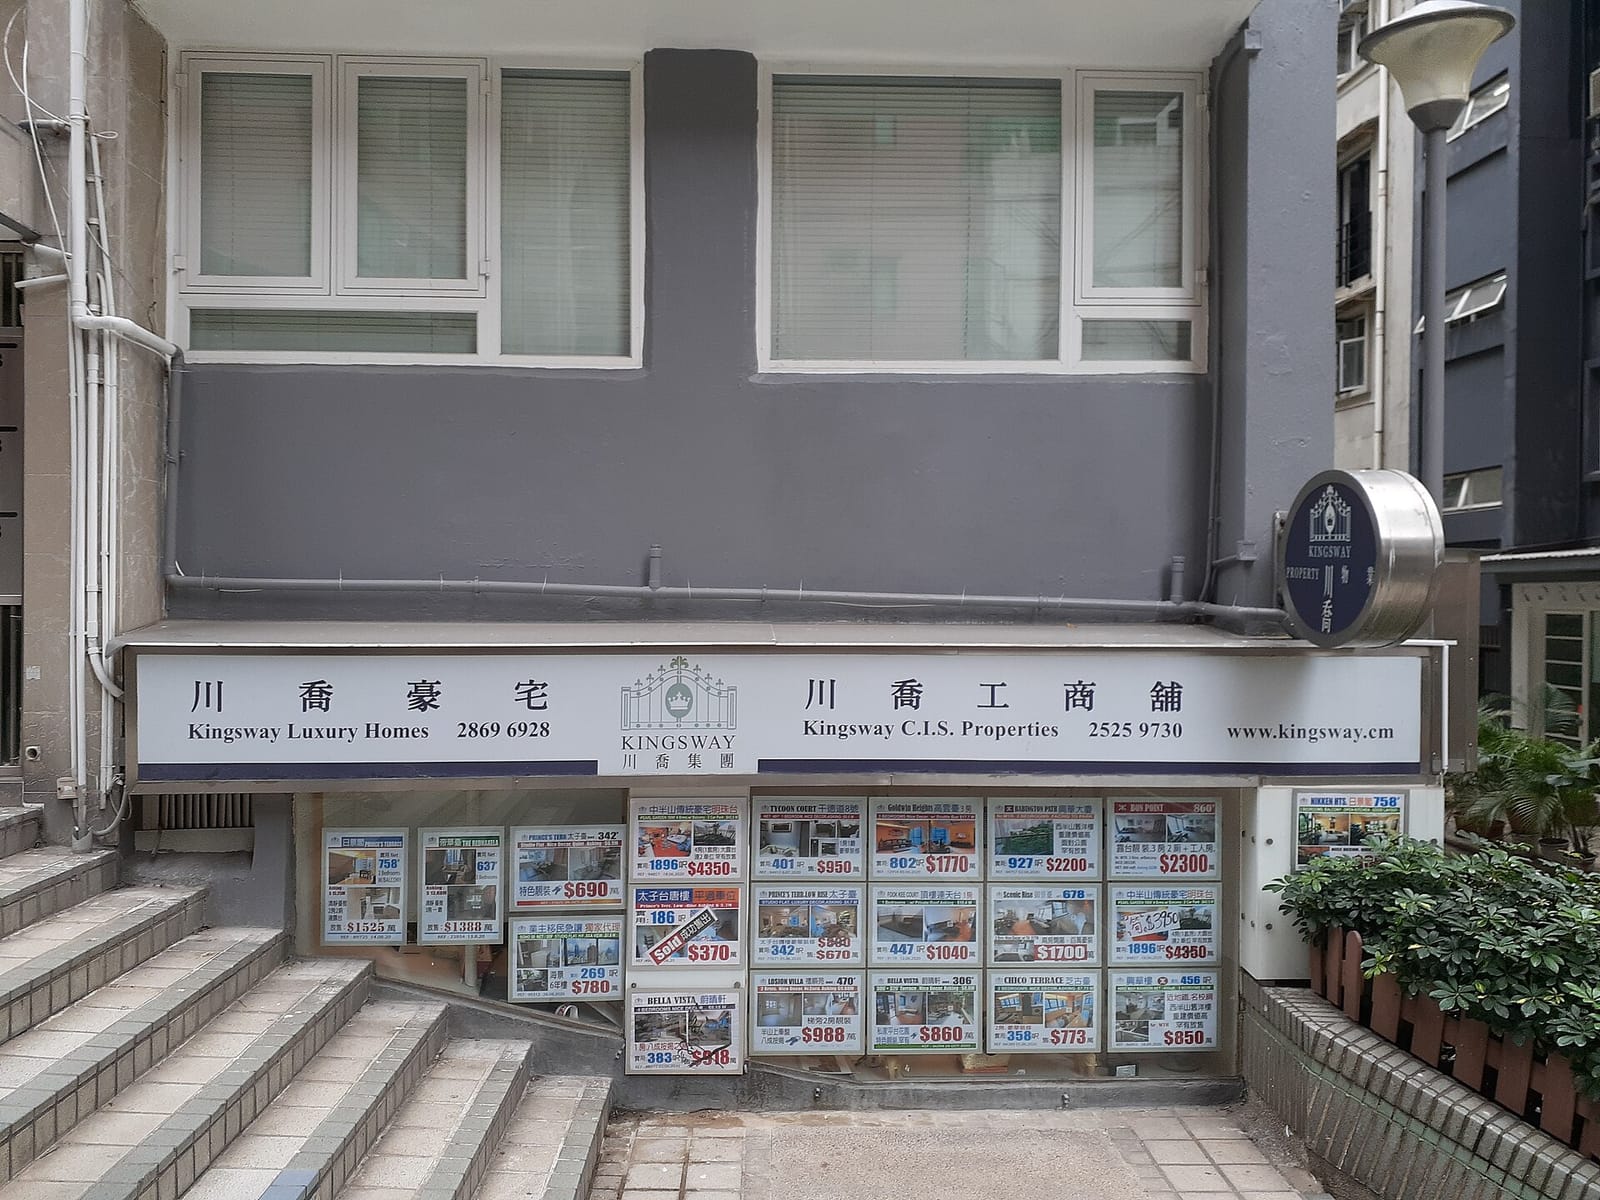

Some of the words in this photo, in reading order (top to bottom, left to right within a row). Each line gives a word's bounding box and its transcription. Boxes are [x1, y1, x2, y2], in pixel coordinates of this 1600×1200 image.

[1309, 546, 1351, 558] KINGSWAY
[1286, 567, 1320, 580] PROPERTY
[190, 680, 549, 712] 川喬豪宅
[804, 679, 1183, 712] 川喬工商舖
[188, 723, 281, 744] Kingsway
[288, 722, 359, 744] Luxury
[364, 722, 429, 739] Homes
[457, 722, 500, 740] 2869
[506, 722, 550, 739] 6928
[802, 720, 895, 742] Kingsway
[901, 721, 955, 738] C.I.S.
[961, 720, 1059, 741] Properties
[1088, 722, 1134, 739] 2525
[1139, 721, 1183, 739] 9730
[1228, 722, 1394, 744] www.kingsway.cm
[622, 735, 737, 752] KINGSWAY
[622, 753, 735, 770] 川喬集團
[1145, 804, 1164, 812] POINT
[649, 859, 678, 871] 1896
[688, 861, 730, 877] $4350
[772, 859, 795, 869] 401
[817, 860, 852, 874] $950
[890, 858, 916, 869] 802
[926, 855, 969, 874] $1770
[1008, 857, 1033, 869] 927
[1047, 857, 1087, 872] $2200
[1160, 854, 1208, 874] $2300
[564, 882, 608, 899] $690
[638, 891, 690, 902] 太子台唐樓
[1063, 890, 1085, 899] 678
[650, 911, 675, 924] 186
[347, 922, 385, 933] $1525
[444, 922, 482, 933] $1388
[654, 936, 684, 961] Sold
[688, 944, 730, 962] $370
[771, 945, 795, 956] 342
[816, 950, 851, 961] $670
[890, 944, 914, 955] 447
[927, 945, 968, 961] $1040
[1037, 945, 1086, 960] $1700
[1128, 943, 1156, 954] 1896
[1166, 945, 1207, 960] $4350
[581, 968, 605, 979] 269
[1004, 977, 1027, 985] CHICO
[1030, 977, 1065, 985] TERRACE
[1180, 976, 1201, 984] 456
[572, 980, 610, 995] $780
[648, 997, 672, 1005] BELLA
[674, 996, 697, 1004] VISTA
[802, 1027, 845, 1044] $988
[920, 1026, 963, 1043] $860
[1007, 1031, 1031, 1041] 358
[1051, 1029, 1086, 1045] $773
[1164, 1030, 1204, 1046] $850
[648, 1052, 672, 1063] 383
